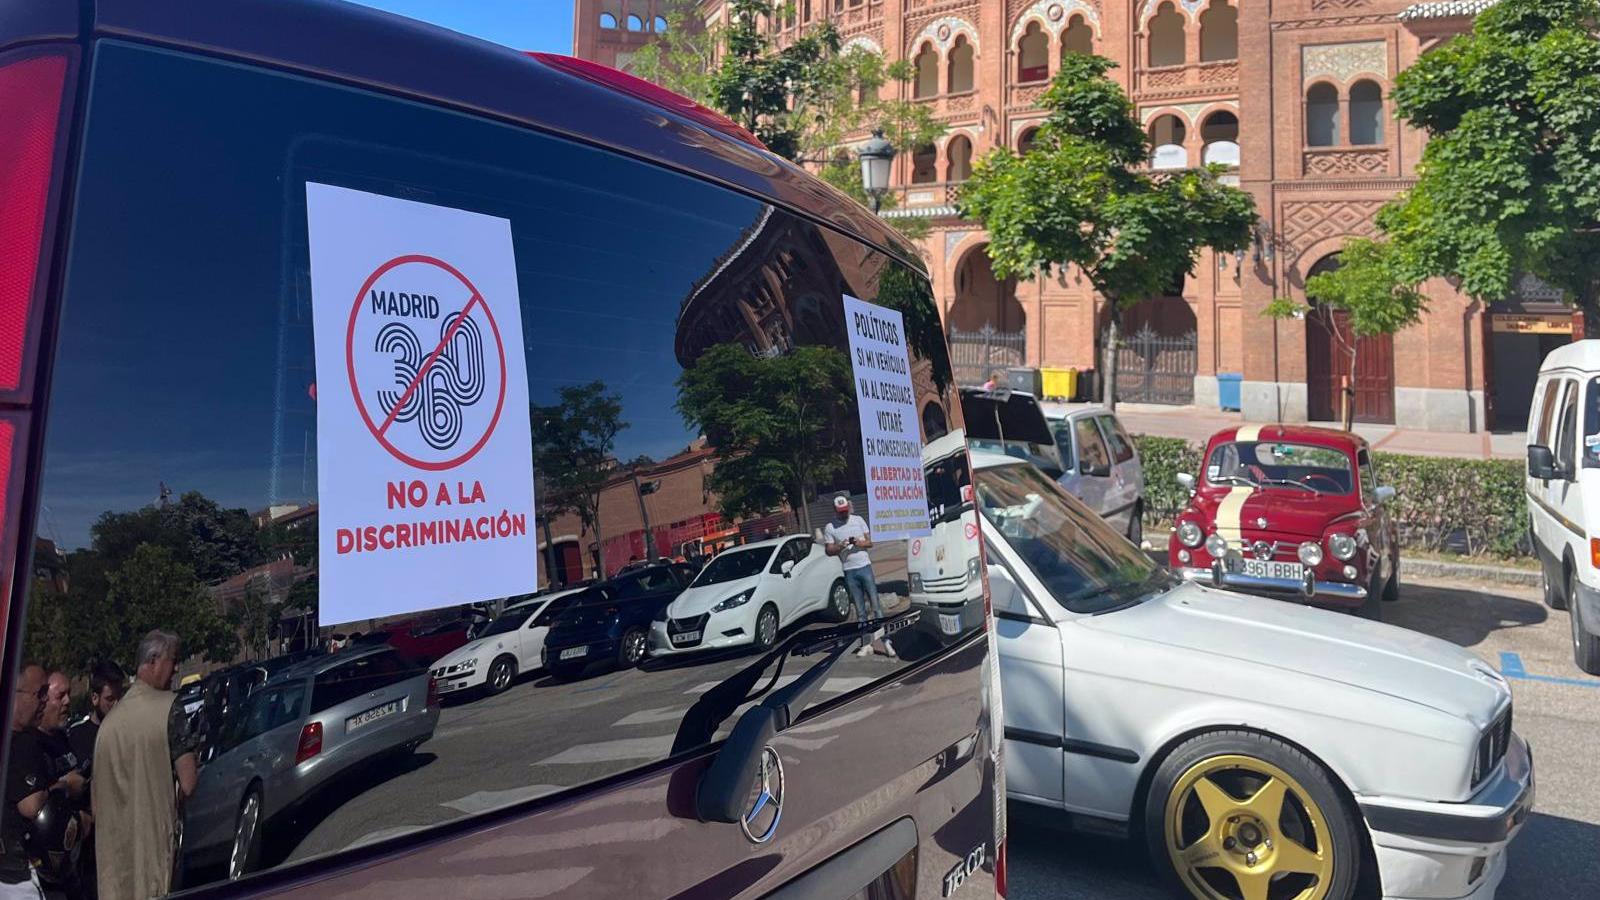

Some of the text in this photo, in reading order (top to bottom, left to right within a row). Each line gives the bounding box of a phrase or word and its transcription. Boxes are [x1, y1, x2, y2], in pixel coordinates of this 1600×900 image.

[371, 290, 440, 319] MADRID
[854, 311, 900, 346] POLÍTICOS
[856, 347, 907, 375] SI MI VEHÍCULO
[374, 311, 485, 450] 360
[859, 377, 913, 405] VA AL DESGUACE
[876, 408, 904, 433] VOTARÉ
[866, 438, 920, 460] EN CONSECUENCIA
[870, 465, 923, 482] #LIBERTAD DE
[387, 480, 486, 509] NO A LA
[874, 482, 924, 501] CIRCULACIÓN
[336, 509, 526, 554] DISCRIMINACIÓN
[1274, 563, 1301, 578] BBH
[966, 842, 986, 877] CDI
